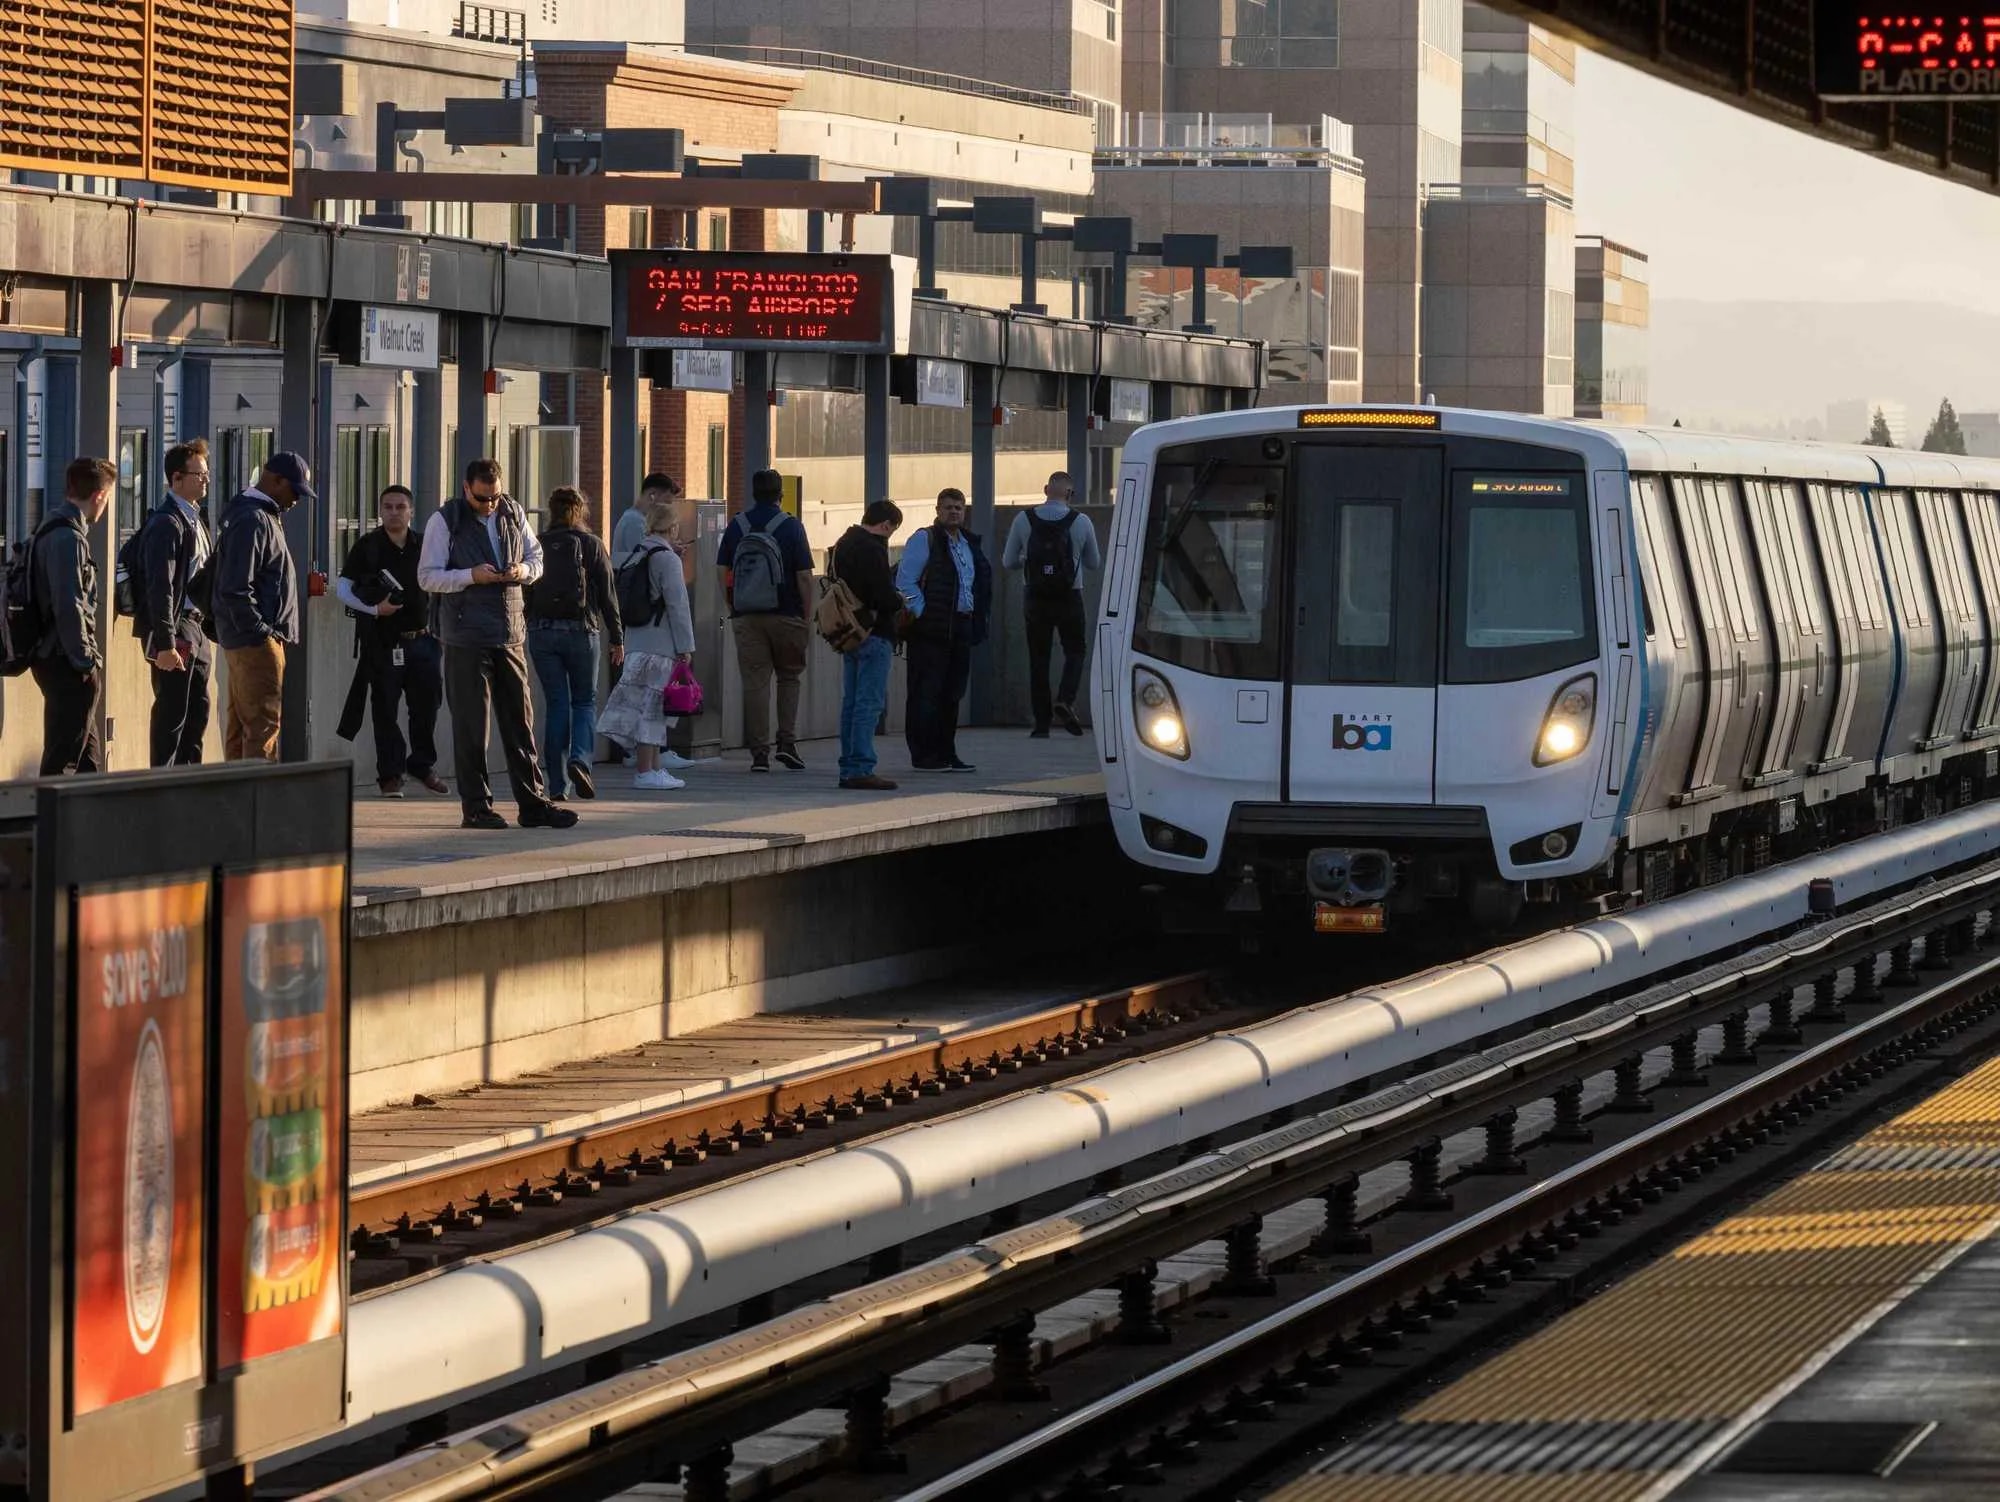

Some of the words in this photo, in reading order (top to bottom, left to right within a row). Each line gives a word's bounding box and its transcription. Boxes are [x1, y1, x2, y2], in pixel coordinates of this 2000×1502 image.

[380, 319, 404, 351] Walnut
[405, 322, 425, 353] Creek
[103, 950, 149, 1009] save
